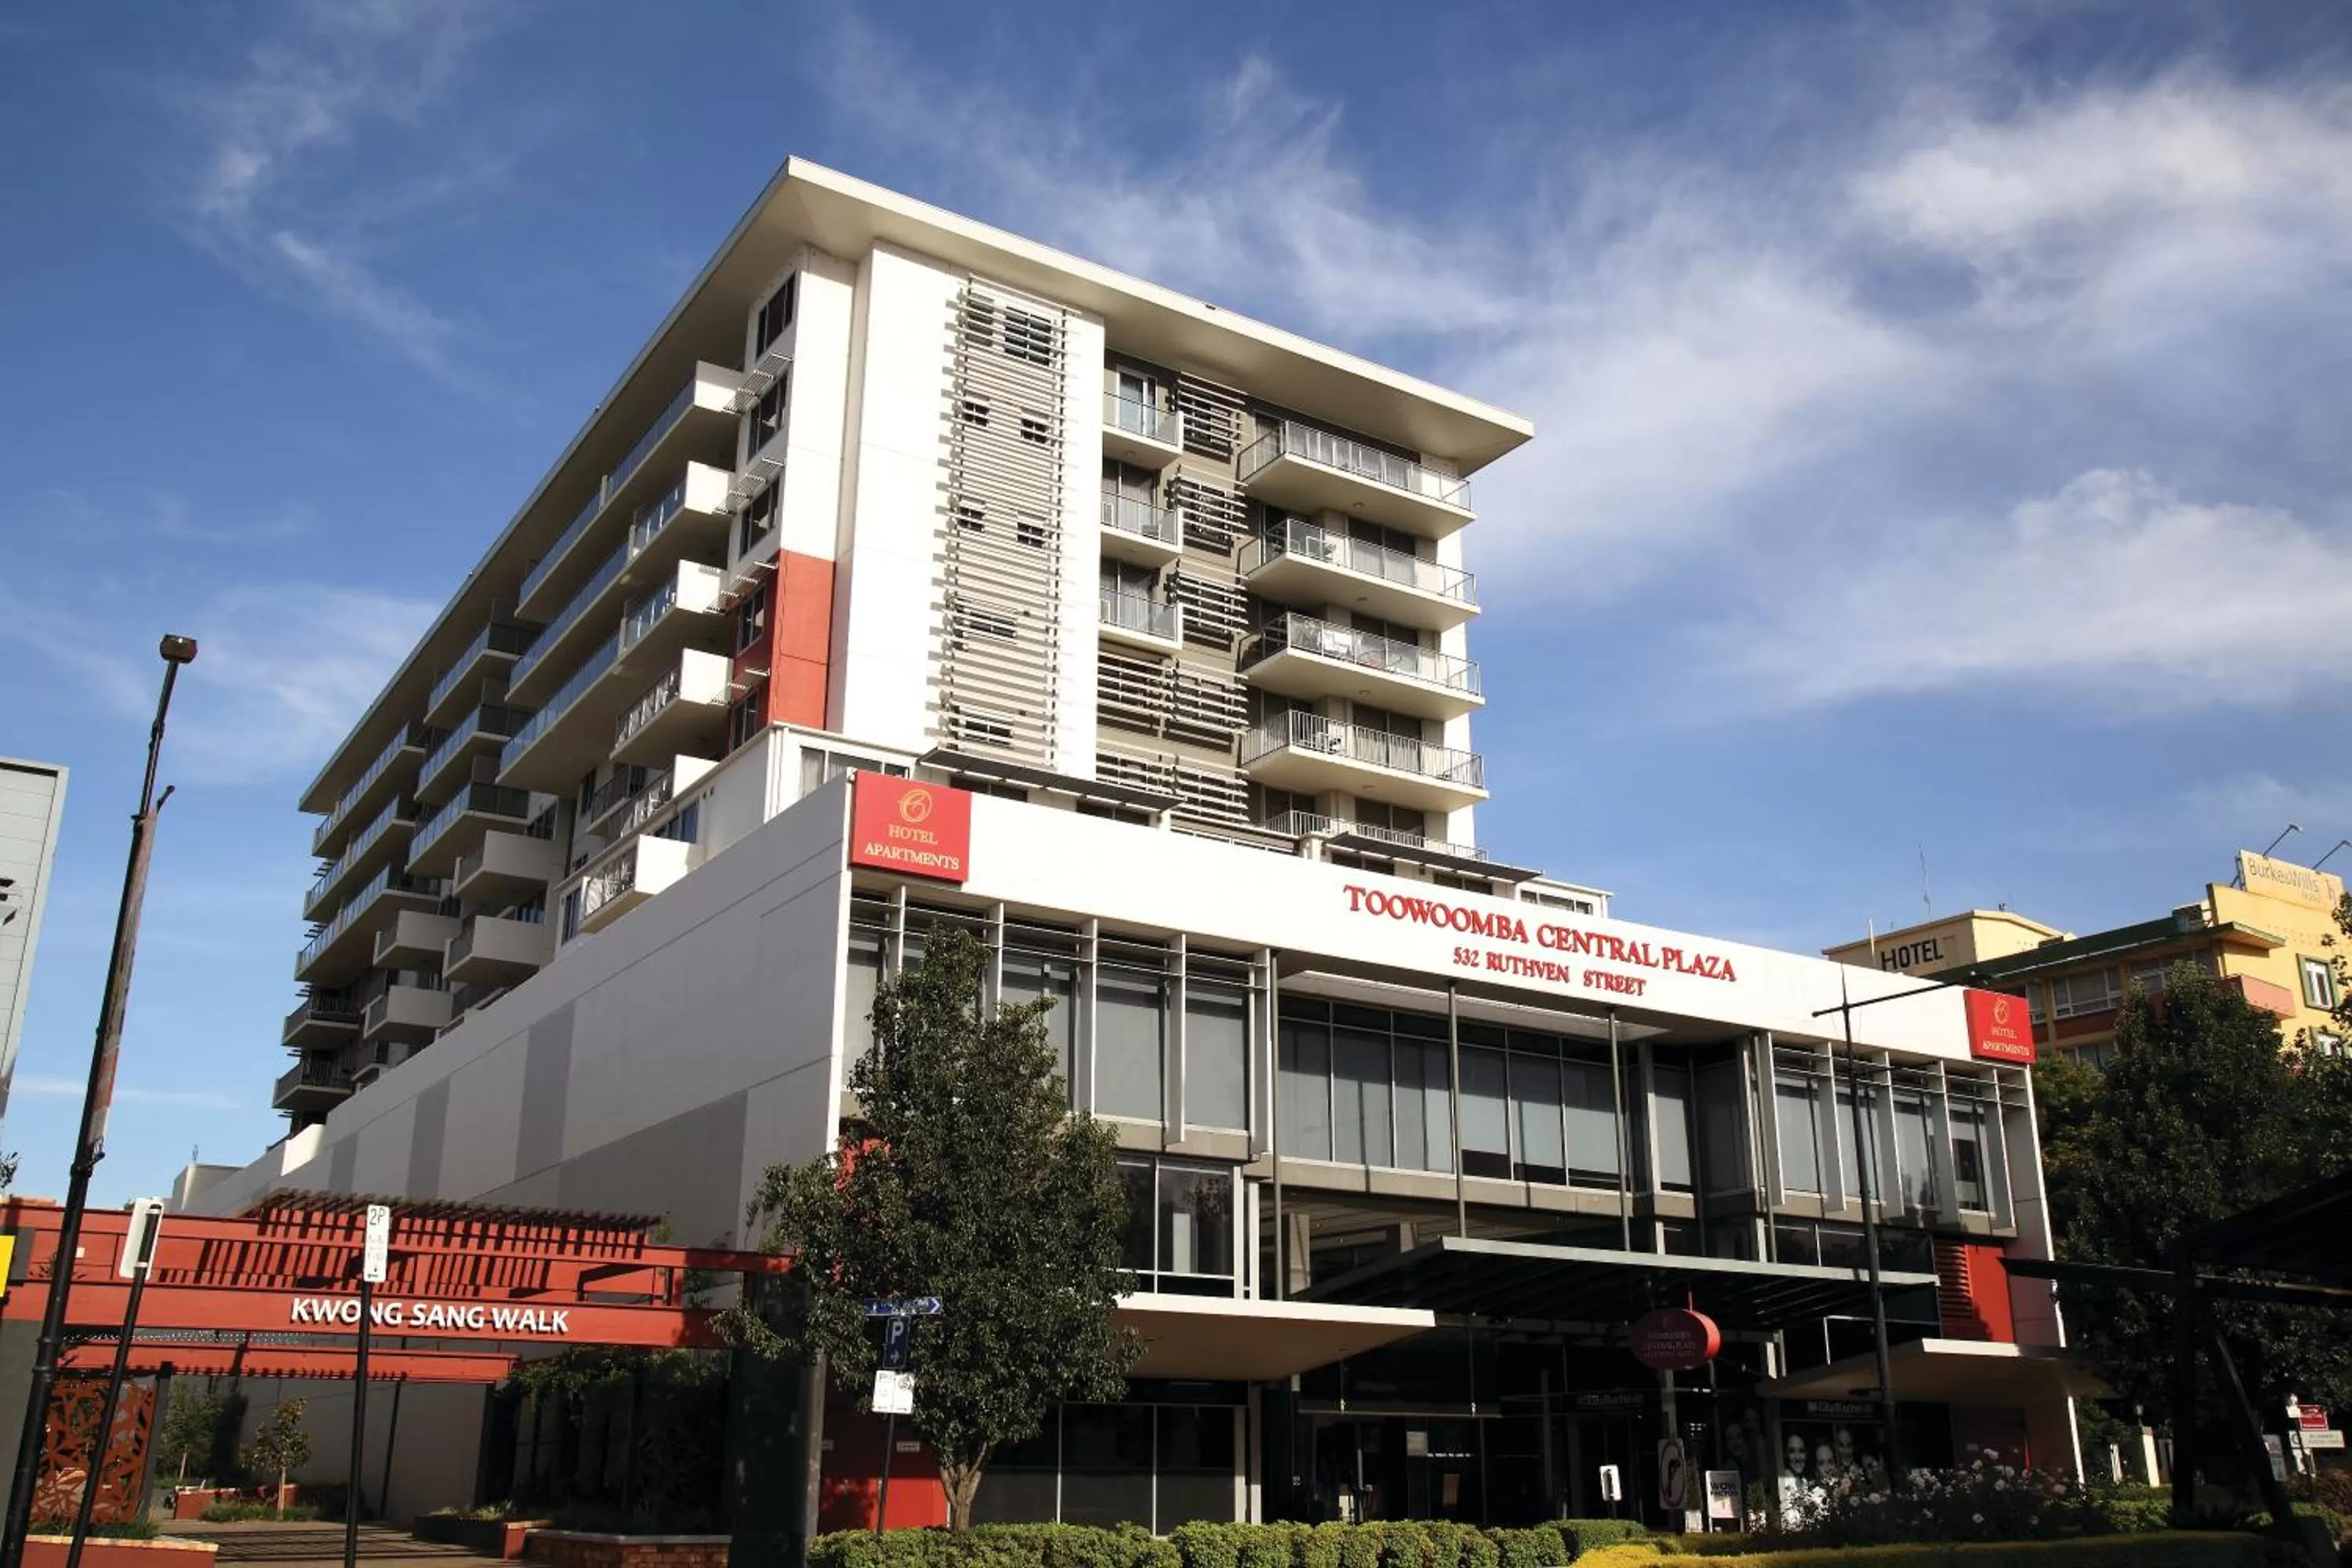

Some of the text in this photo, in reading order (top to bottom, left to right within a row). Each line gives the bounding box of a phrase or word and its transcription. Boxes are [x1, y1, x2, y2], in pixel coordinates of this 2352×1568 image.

[888, 824, 938, 845] HOTEL
[865, 842, 960, 870] APARTMENTS
[1343, 884, 1737, 982] TOOWOOMBA CENTRAL PLAZA
[1881, 938, 1944, 971] HOTEL
[1453, 946, 1647, 996] 532 RUTHVEN STREET
[1982, 1040, 2030, 1056] APARTMENTS
[369, 1207, 385, 1226] 2P
[291, 1298, 569, 1332] KWONG SANG WALK
[891, 1320, 904, 1345] P
